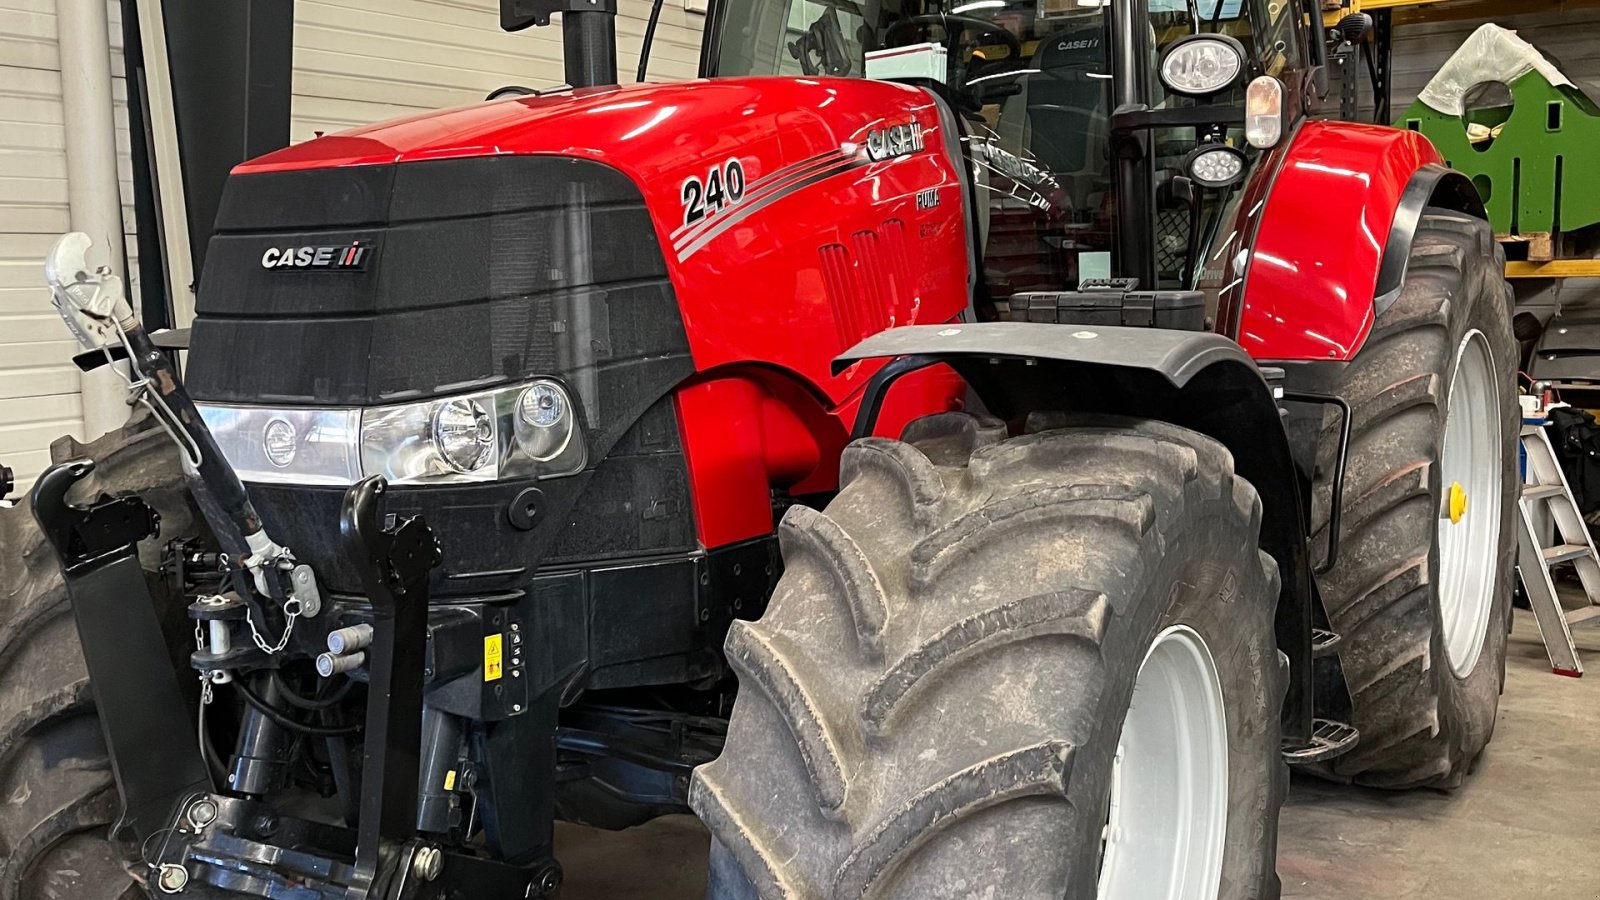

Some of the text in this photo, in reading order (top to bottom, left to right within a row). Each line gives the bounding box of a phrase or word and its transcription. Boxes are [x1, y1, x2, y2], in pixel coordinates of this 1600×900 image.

[1057, 40, 1087, 50] CASE
[867, 125, 911, 160] CASE
[681, 157, 745, 228] 240
[916, 188, 940, 211] PUMA
[261, 246, 334, 269] CASE
